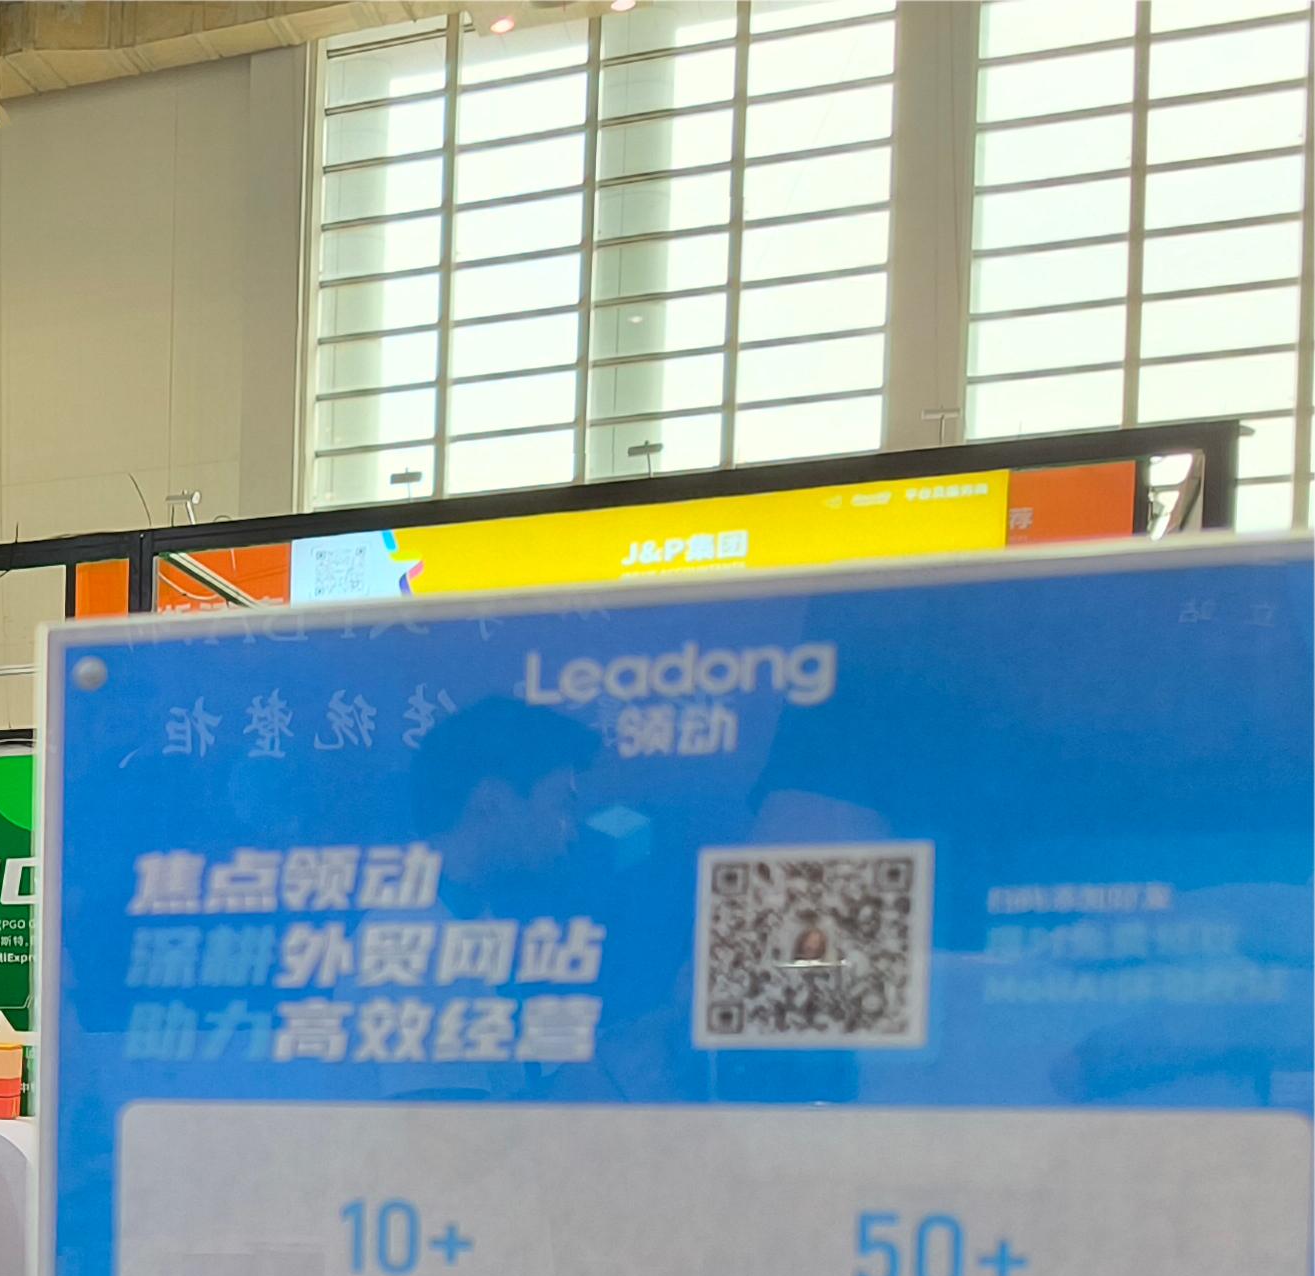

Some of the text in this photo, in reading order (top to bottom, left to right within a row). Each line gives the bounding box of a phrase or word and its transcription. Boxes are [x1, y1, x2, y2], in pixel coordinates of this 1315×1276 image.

[621, 530, 748, 566] J&P集团
[525, 641, 836, 706] Leadong
[616, 704, 737, 758] 领动
[126, 843, 444, 915] 焦点领动
[123, 995, 603, 1063] 助力高效经营
